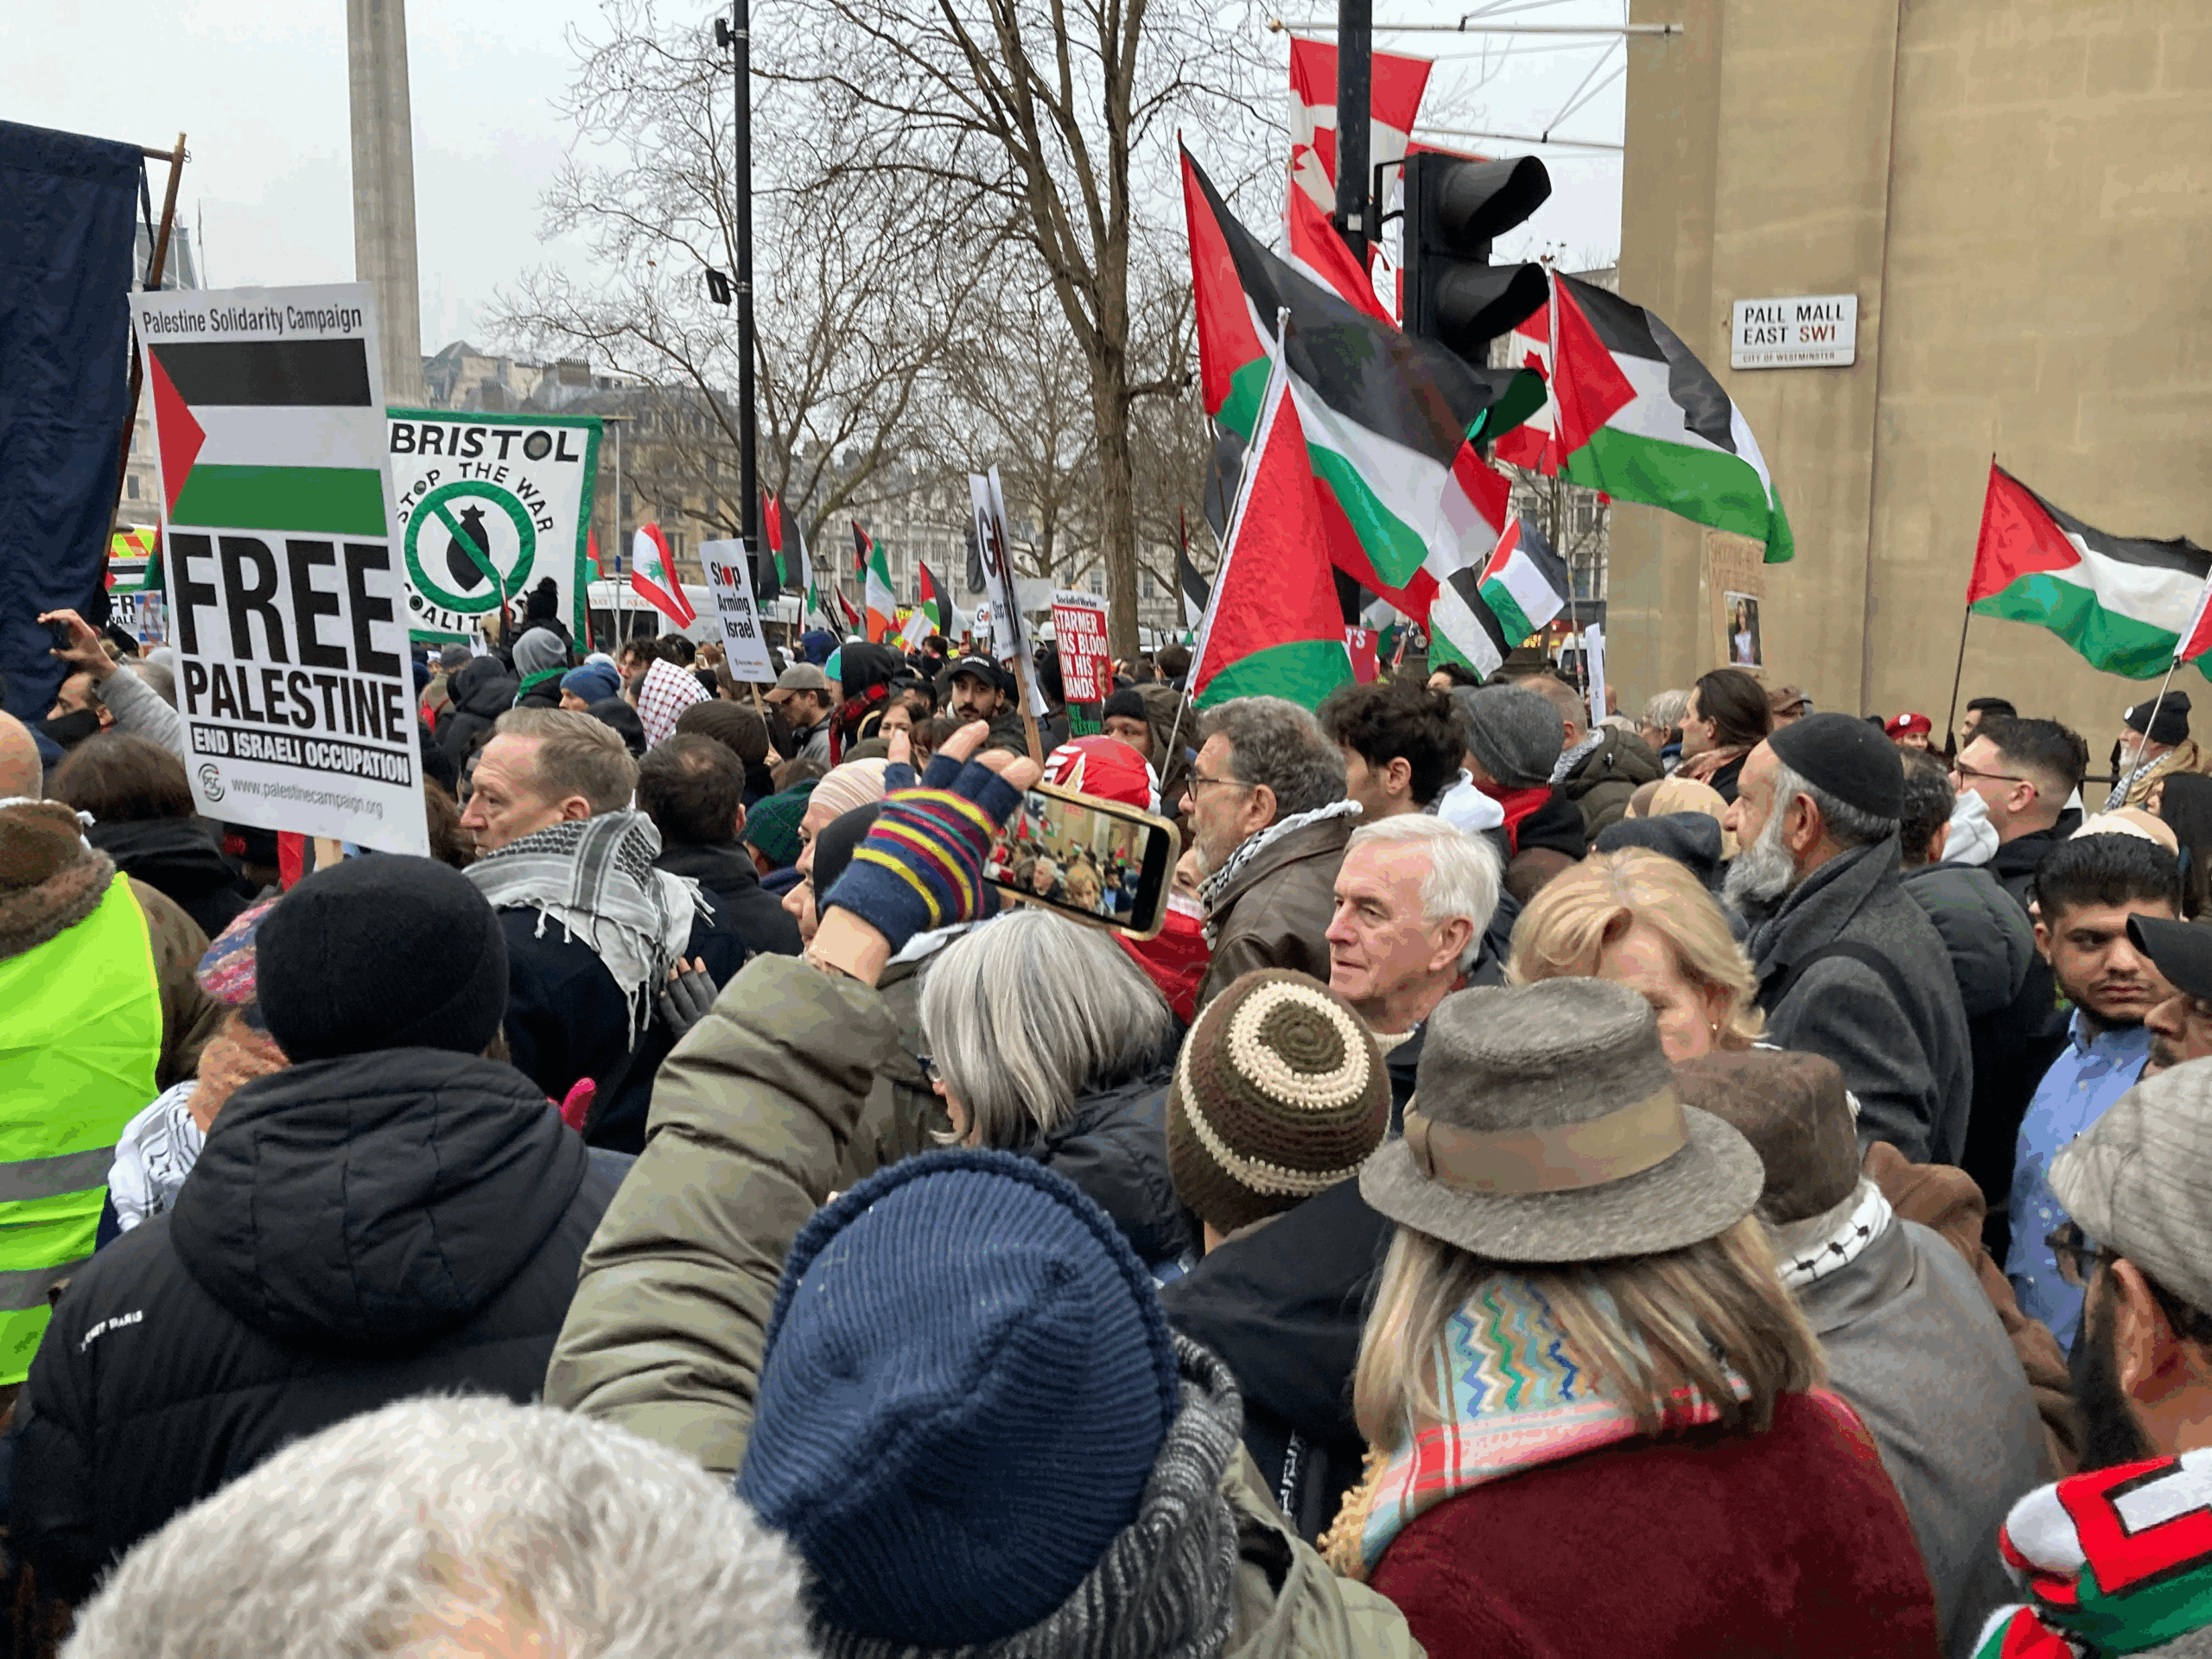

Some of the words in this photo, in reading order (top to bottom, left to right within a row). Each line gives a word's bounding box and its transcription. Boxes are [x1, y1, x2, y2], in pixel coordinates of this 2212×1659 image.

[142, 310, 207, 334] Palestine
[210, 308, 283, 335] Solidarity
[287, 303, 363, 334] Campaign
[1745, 305, 1785, 324] PALL
[1796, 303, 1845, 322] MALL
[1744, 327, 1789, 346] EAST
[1800, 325, 1835, 343] SW1
[1743, 353, 1760, 363] CITY
[1764, 353, 1773, 362] OF
[1777, 352, 1834, 361] WESTMINSTER
[390, 423, 579, 462] BRISTOL
[397, 469, 441, 523] STOP
[459, 462, 510, 484] THE
[517, 477, 554, 533] WAR
[710, 561, 741, 592] Stop
[168, 531, 403, 678] FREE
[716, 593, 751, 616] Arming
[723, 616, 756, 639] Israel
[1053, 607, 1098, 634] STARMER
[1057, 632, 1076, 655] HAS
[1077, 632, 1108, 658] BLOOD
[1060, 654, 1073, 677] ON
[1075, 654, 1094, 677] HIS
[1064, 676, 1096, 700] HANDS
[181, 660, 409, 744] PALESTINE
[194, 727, 229, 754] END
[232, 731, 302, 765] ISRAELI
[305, 741, 410, 783] OCCUPATION
[231, 778, 384, 820] www.palestinecampaign.org
